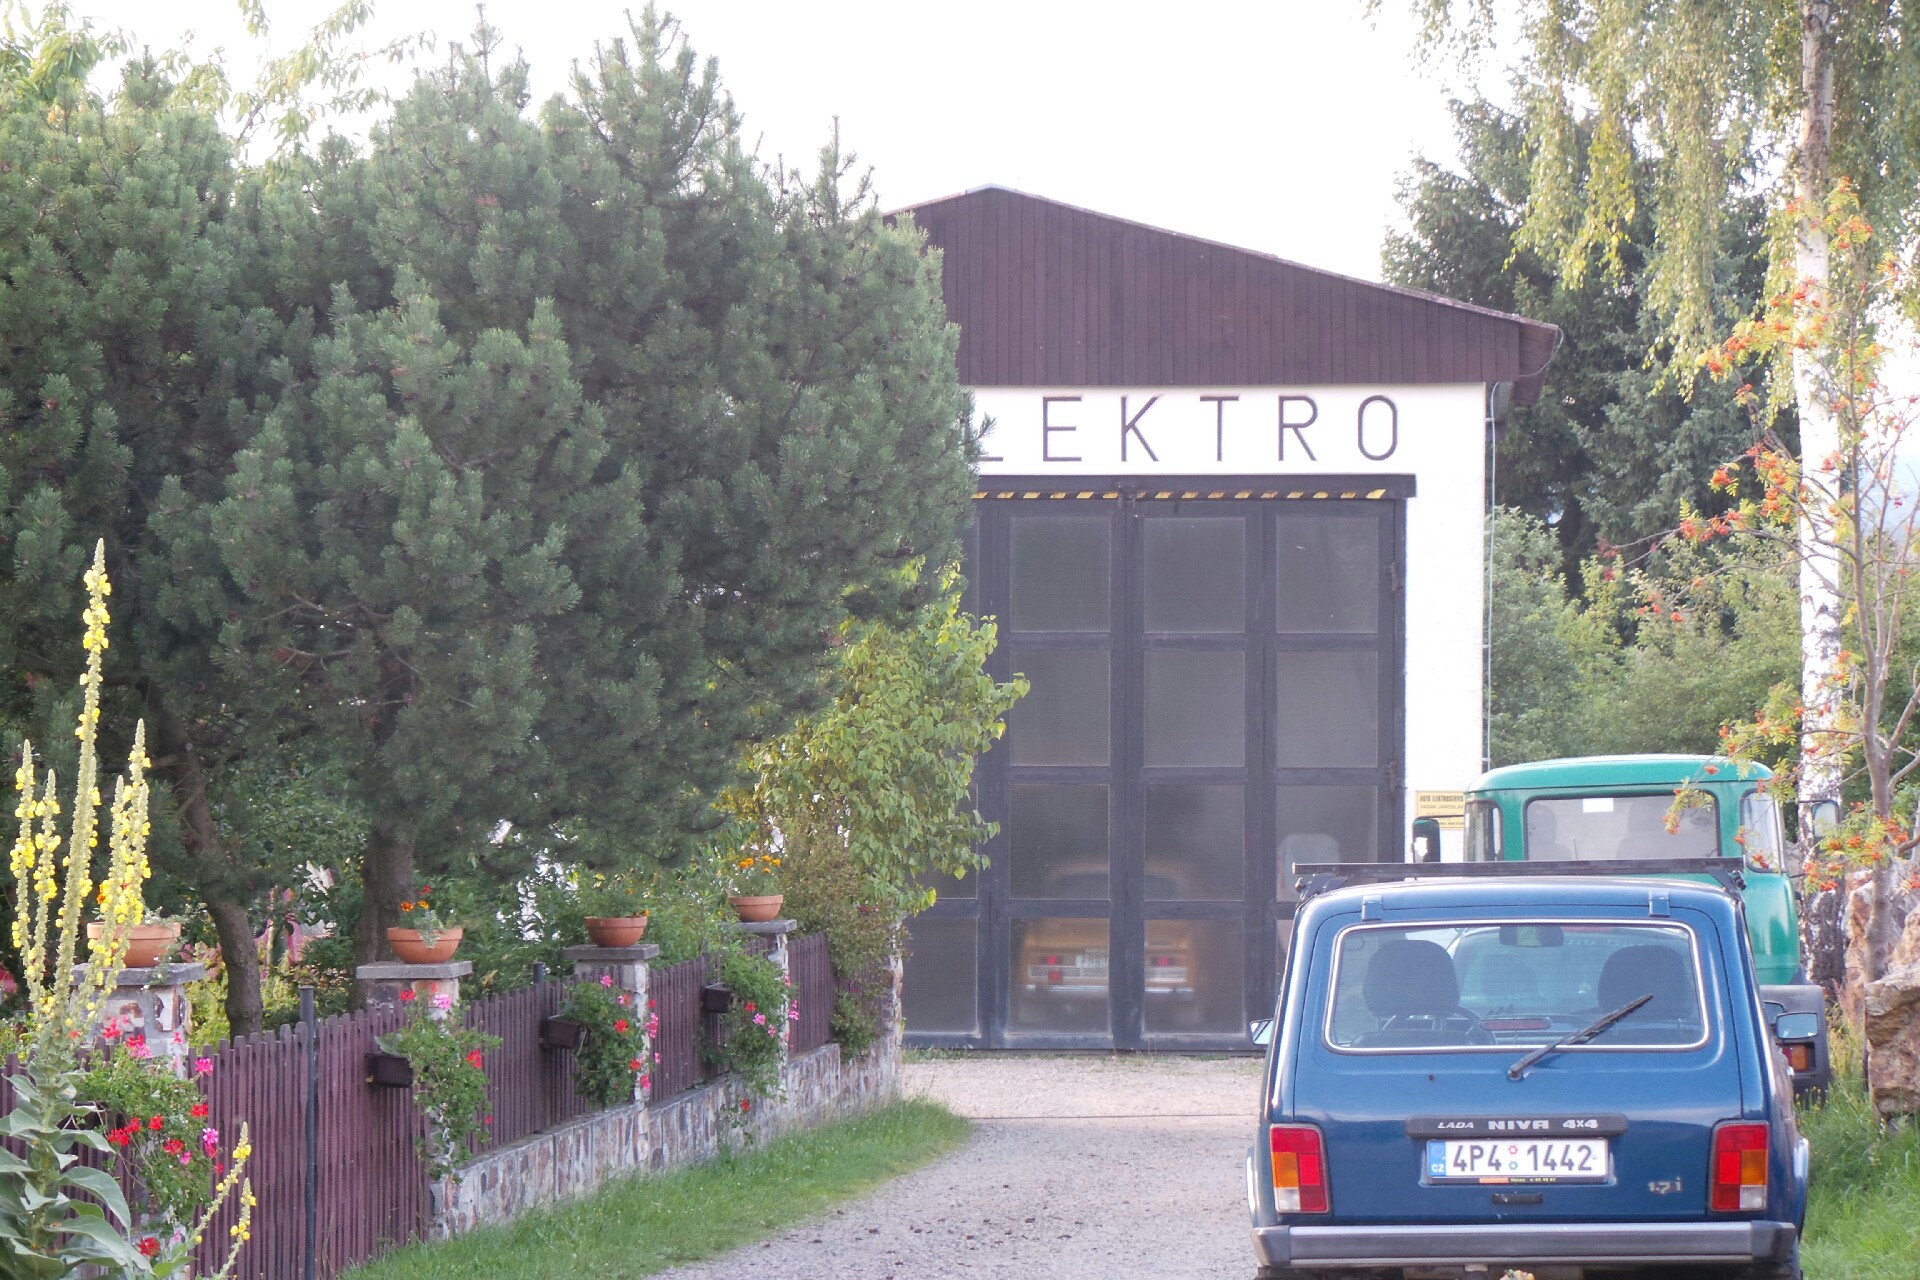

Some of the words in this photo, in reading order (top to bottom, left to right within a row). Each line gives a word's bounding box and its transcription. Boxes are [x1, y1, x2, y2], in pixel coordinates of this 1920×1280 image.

[981, 394, 1398, 462] EKTRO
[1437, 1121, 1474, 1129] LADA
[1488, 1120, 1550, 1130] NIVA
[1453, 1144, 1502, 1172] 4P4
[1526, 1144, 1593, 1172] 1442
[1431, 1164, 1446, 1173] CZ
